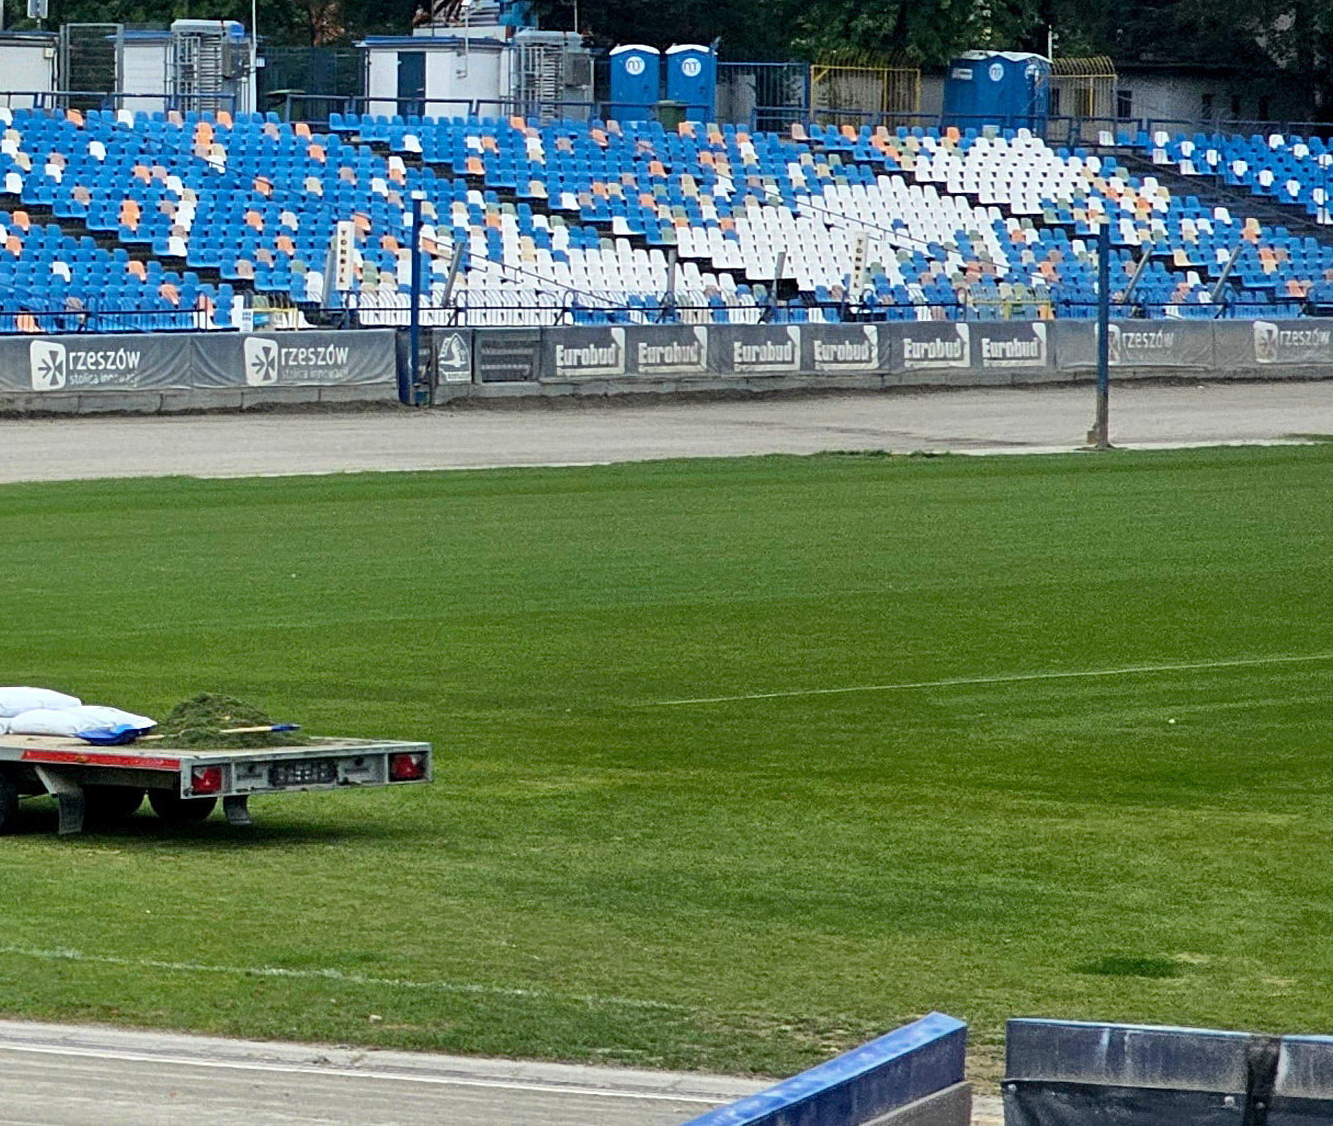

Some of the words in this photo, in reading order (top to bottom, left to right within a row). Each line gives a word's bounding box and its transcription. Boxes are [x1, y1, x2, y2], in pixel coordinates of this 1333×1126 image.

[903, 338, 962, 359] Eurobud
[981, 337, 1039, 358] Eurobud
[1122, 328, 1175, 349] rzeszów
[1279, 328, 1332, 347] rzeszów
[68, 347, 141, 371] rzeszów
[280, 343, 349, 366] rzeszów
[555, 343, 616, 366] Eurobud
[638, 341, 699, 364] Eurobud
[733, 341, 793, 363] Eurobud
[813, 340, 870, 362] Eurobud
